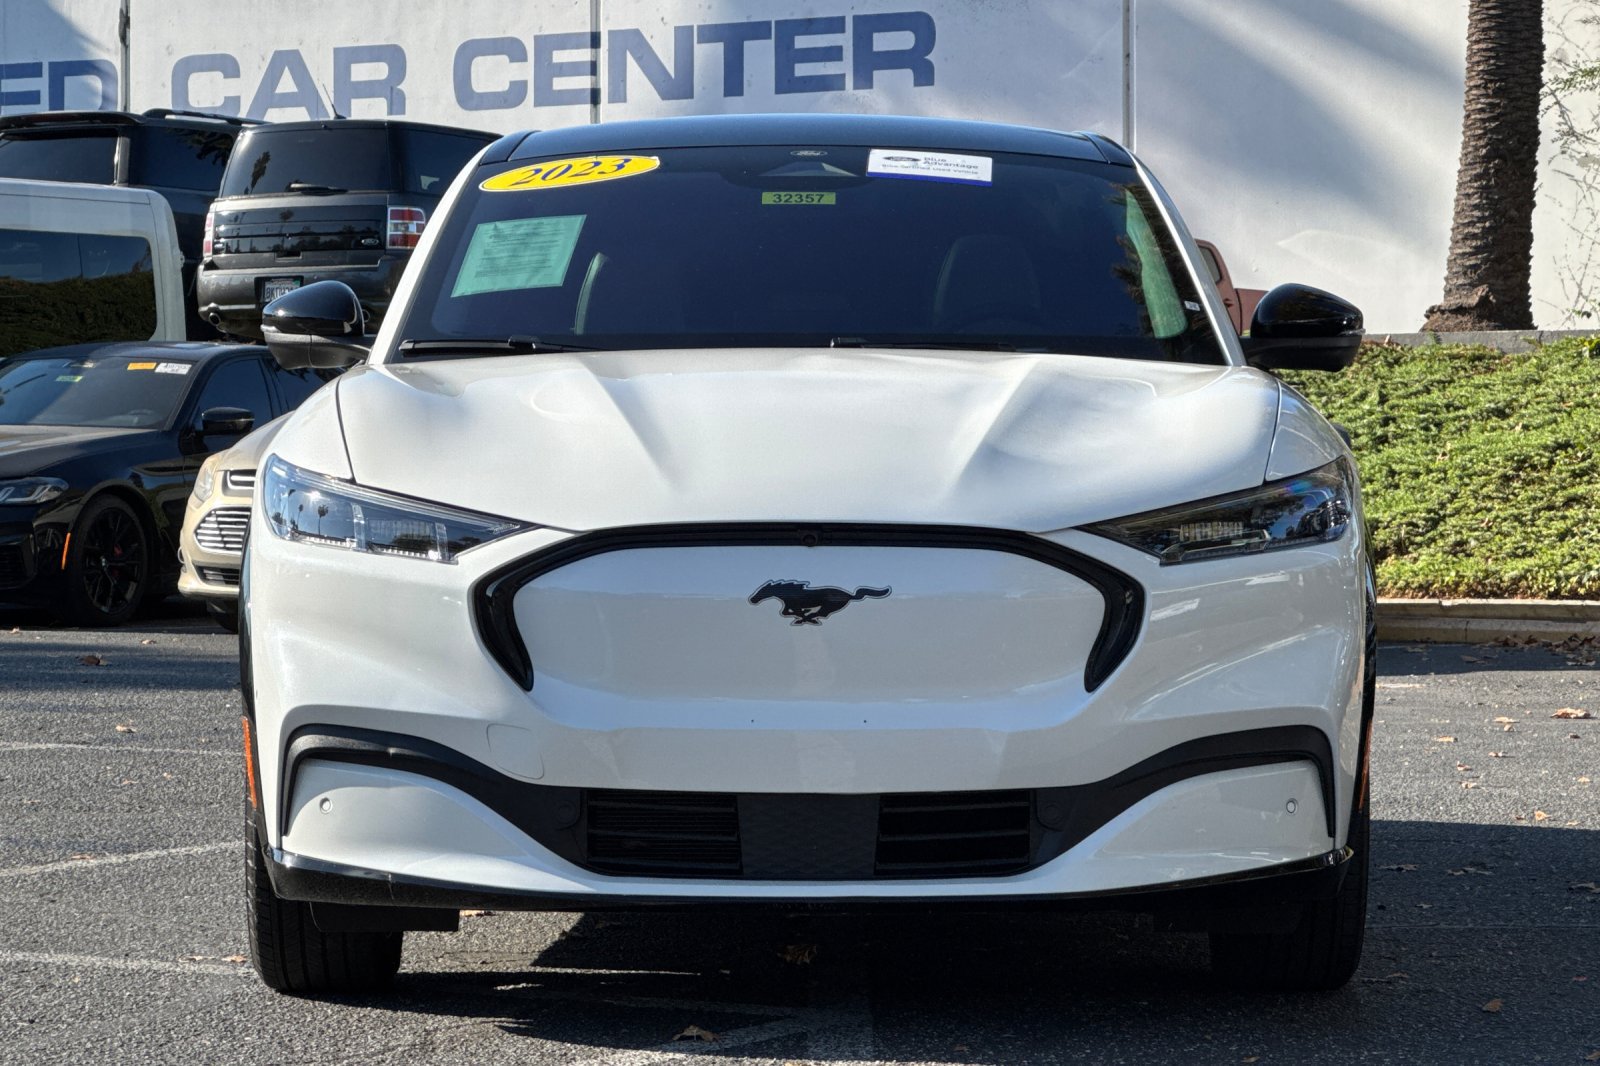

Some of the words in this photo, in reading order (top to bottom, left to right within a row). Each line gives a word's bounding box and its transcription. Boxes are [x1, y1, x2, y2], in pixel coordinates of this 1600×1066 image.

[171, 43, 406, 119] CAR
[453, 11, 936, 111] CENTER
[508, 158, 632, 187] 2023
[923, 161, 979, 170] Advantage
[773, 193, 825, 203] 32357
